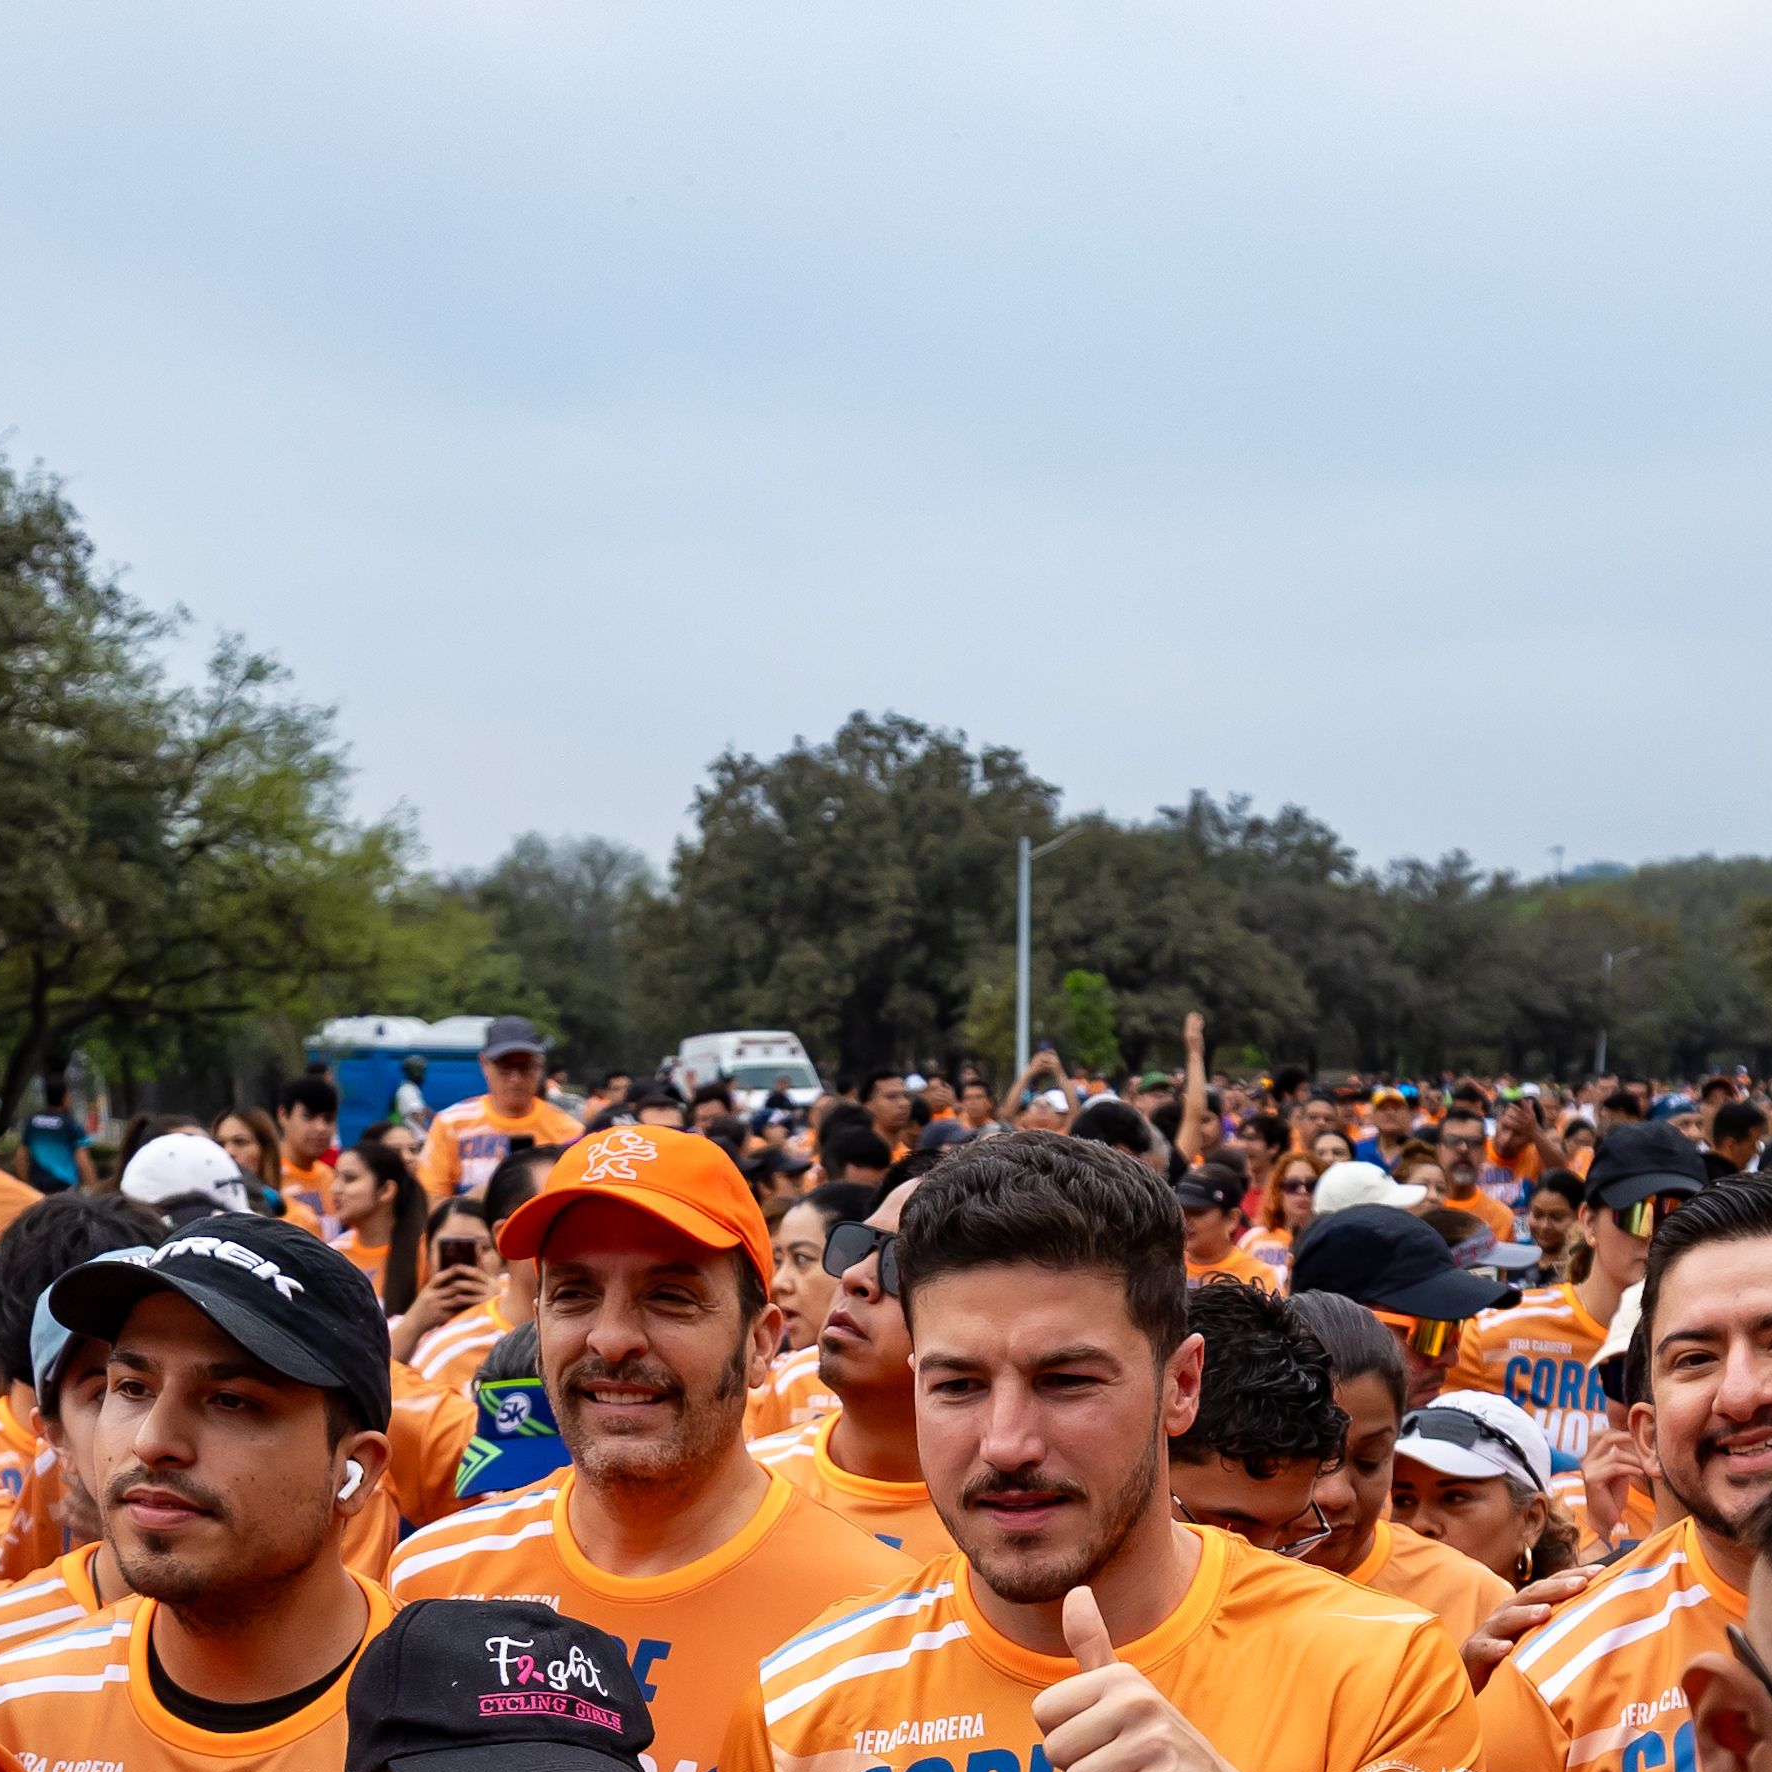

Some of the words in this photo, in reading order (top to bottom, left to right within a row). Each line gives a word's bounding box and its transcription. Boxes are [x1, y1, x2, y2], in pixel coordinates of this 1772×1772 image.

[1504, 1357, 1608, 1411] CORR
[479, 1694, 568, 1714] CYCLING
[575, 1701, 623, 1731] GIRLS
[853, 1726, 898, 1755] 1ERA
[896, 1712, 985, 1746] CARRERA
